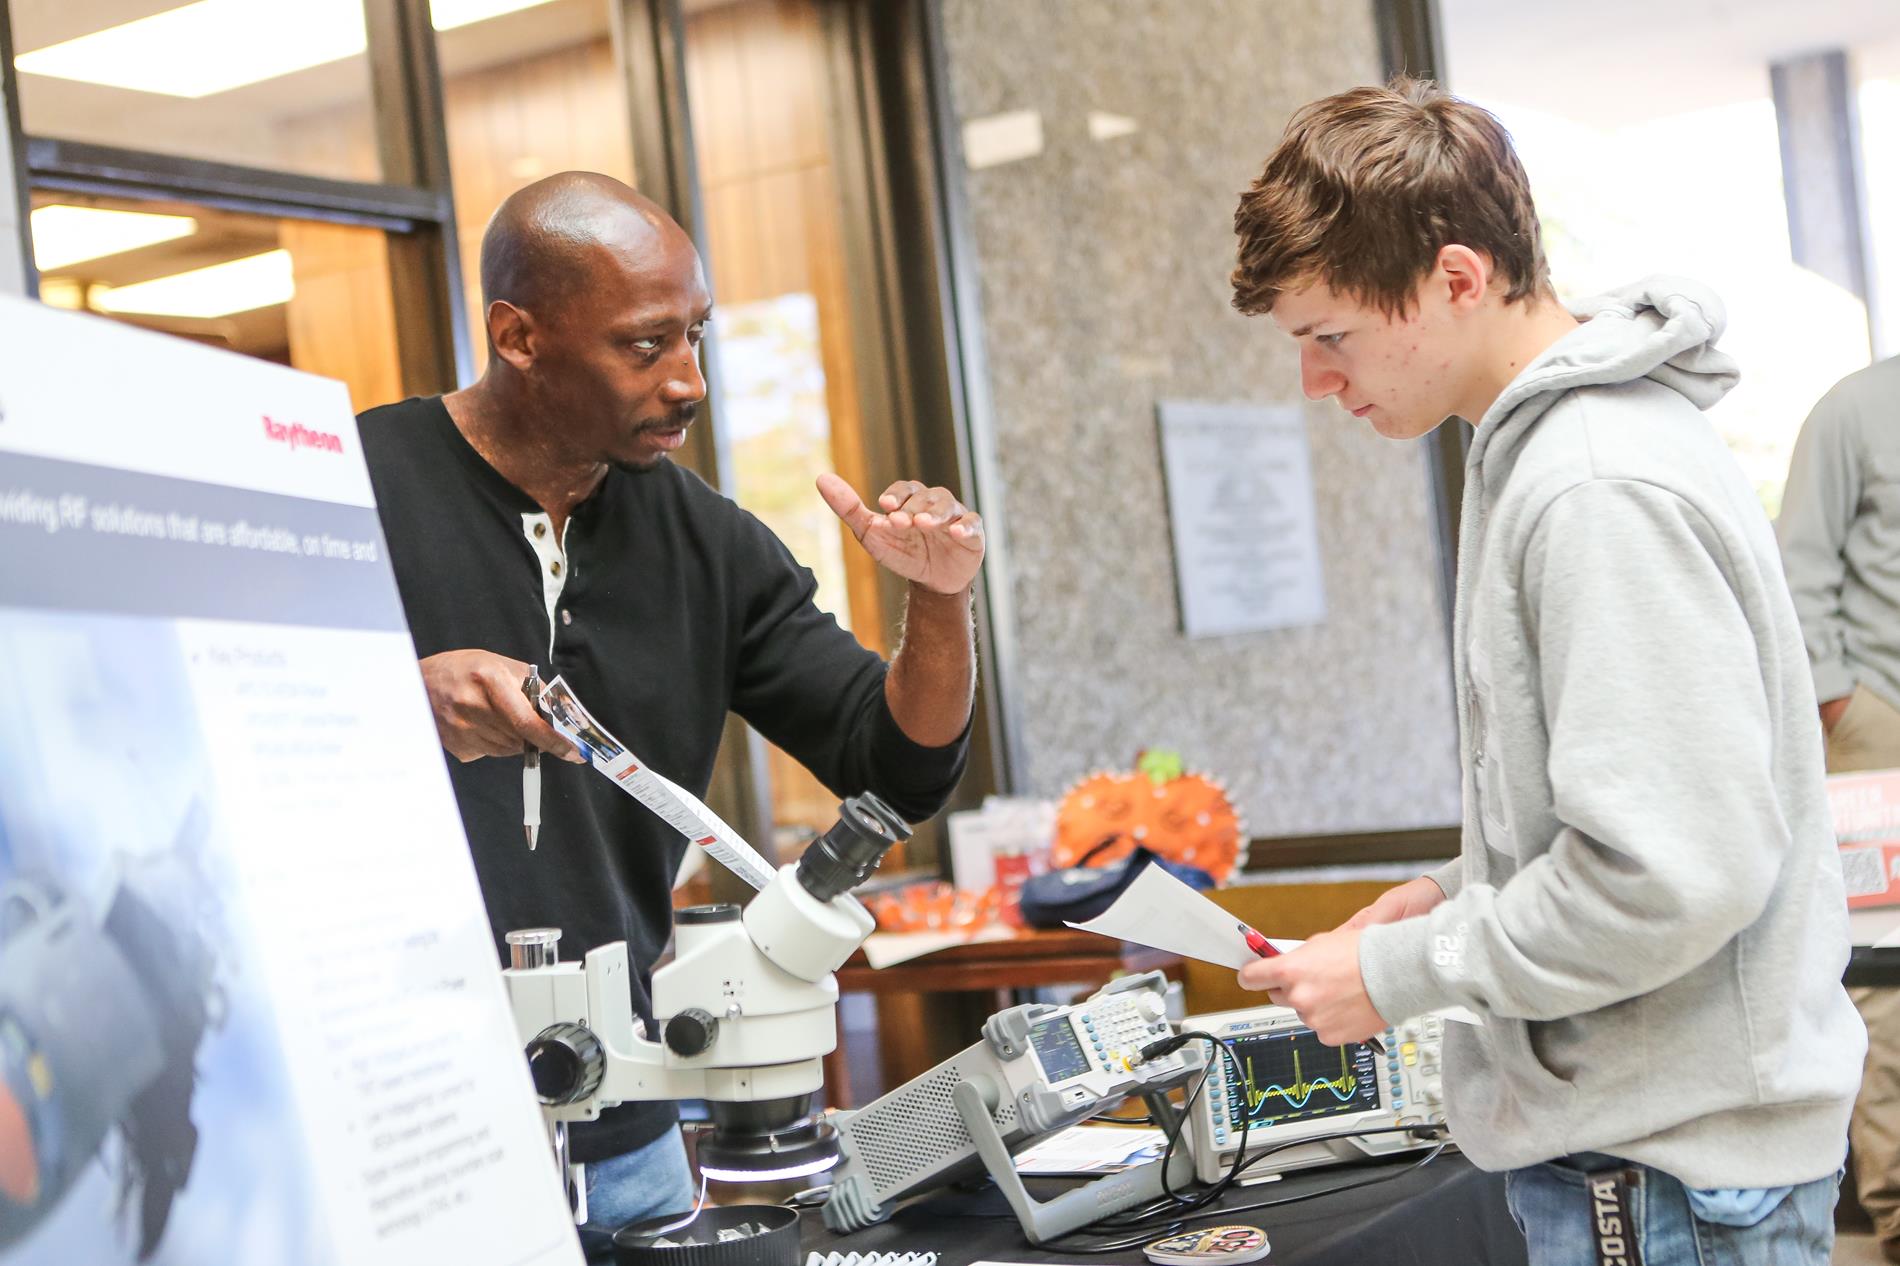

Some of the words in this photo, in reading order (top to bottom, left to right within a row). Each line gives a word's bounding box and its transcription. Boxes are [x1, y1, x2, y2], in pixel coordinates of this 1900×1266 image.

[262, 414, 343, 454] Raytheon
[59, 493, 88, 529] RF
[91, 503, 165, 538] solutions
[167, 512, 198, 541] that
[202, 521, 227, 545] are
[229, 520, 302, 556] affordable,
[302, 534, 321, 557] on
[321, 531, 351, 560] time
[352, 541, 377, 562] and
